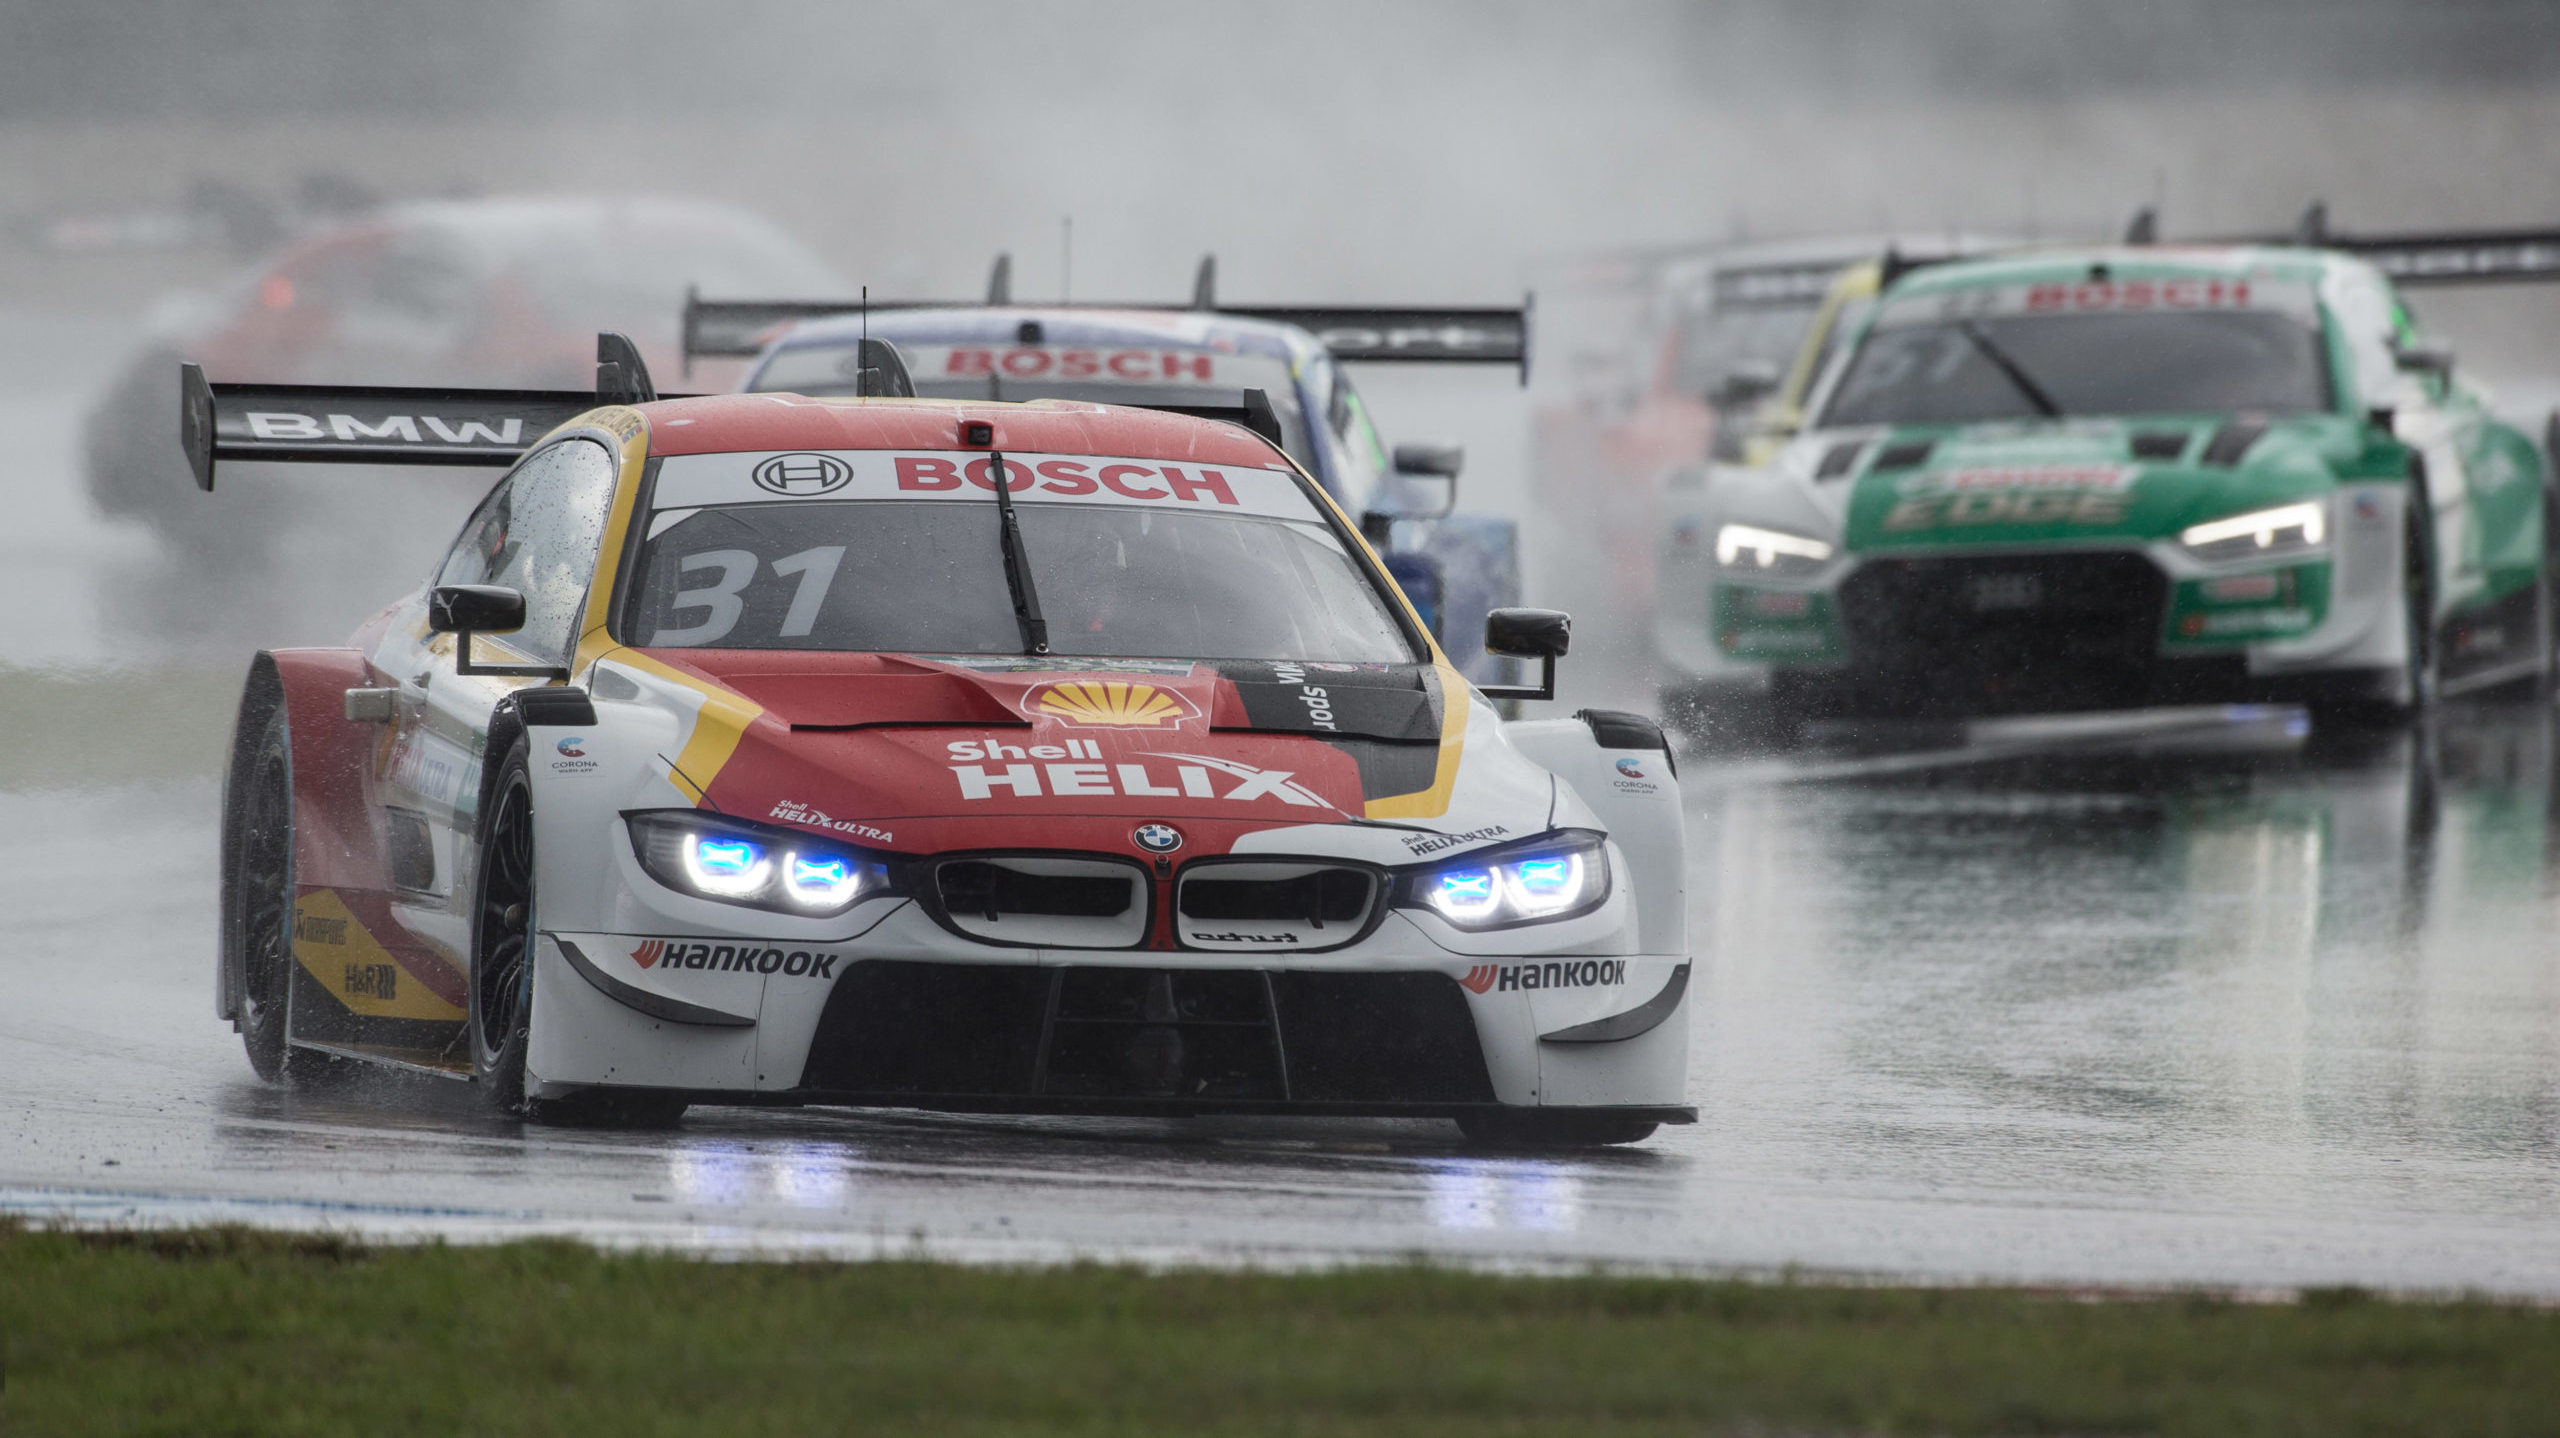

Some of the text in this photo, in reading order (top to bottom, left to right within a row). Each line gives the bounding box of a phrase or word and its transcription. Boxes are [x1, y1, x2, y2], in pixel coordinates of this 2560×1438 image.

[2026, 280, 2251, 310] BOSCH
[946, 346, 1213, 381] BOSCH
[246, 412, 523, 444] BMW
[894, 457, 1240, 506] BOSCH
[653, 545, 846, 648] 31
[552, 761, 599, 769] CORONA
[947, 739, 1103, 760] Shell
[949, 752, 1334, 810] HELIX
[1613, 781, 1659, 790] CORONA
[778, 800, 808, 811] Shell
[769, 807, 893, 843] HELIX ULTRA
[1401, 833, 1426, 846] Shell
[1409, 825, 1510, 857] HELIX ULTRA
